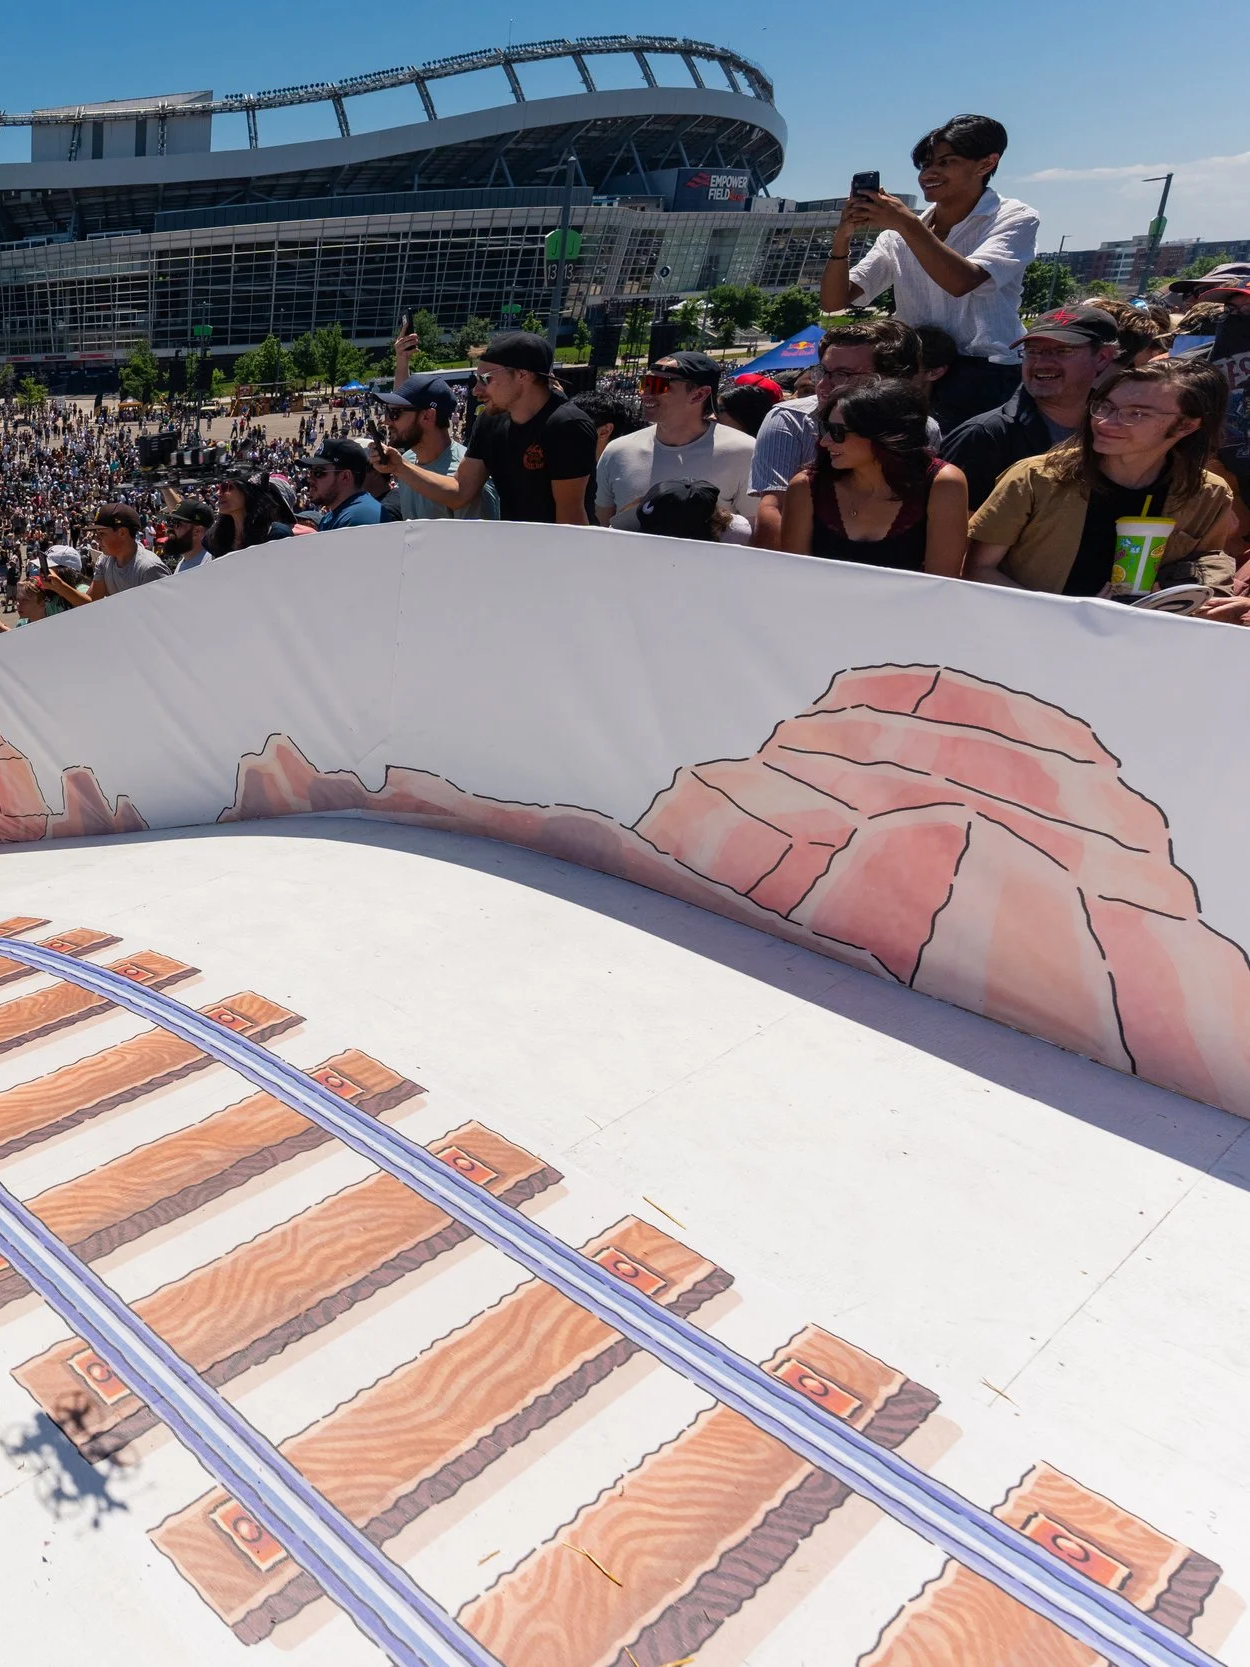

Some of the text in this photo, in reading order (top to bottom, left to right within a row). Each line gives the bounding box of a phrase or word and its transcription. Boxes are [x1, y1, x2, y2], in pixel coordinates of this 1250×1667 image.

[710, 175, 748, 188] EMPOWER
[708, 188, 731, 200] FIELD
[547, 263, 558, 280] 13
[564, 263, 574, 280] 13
